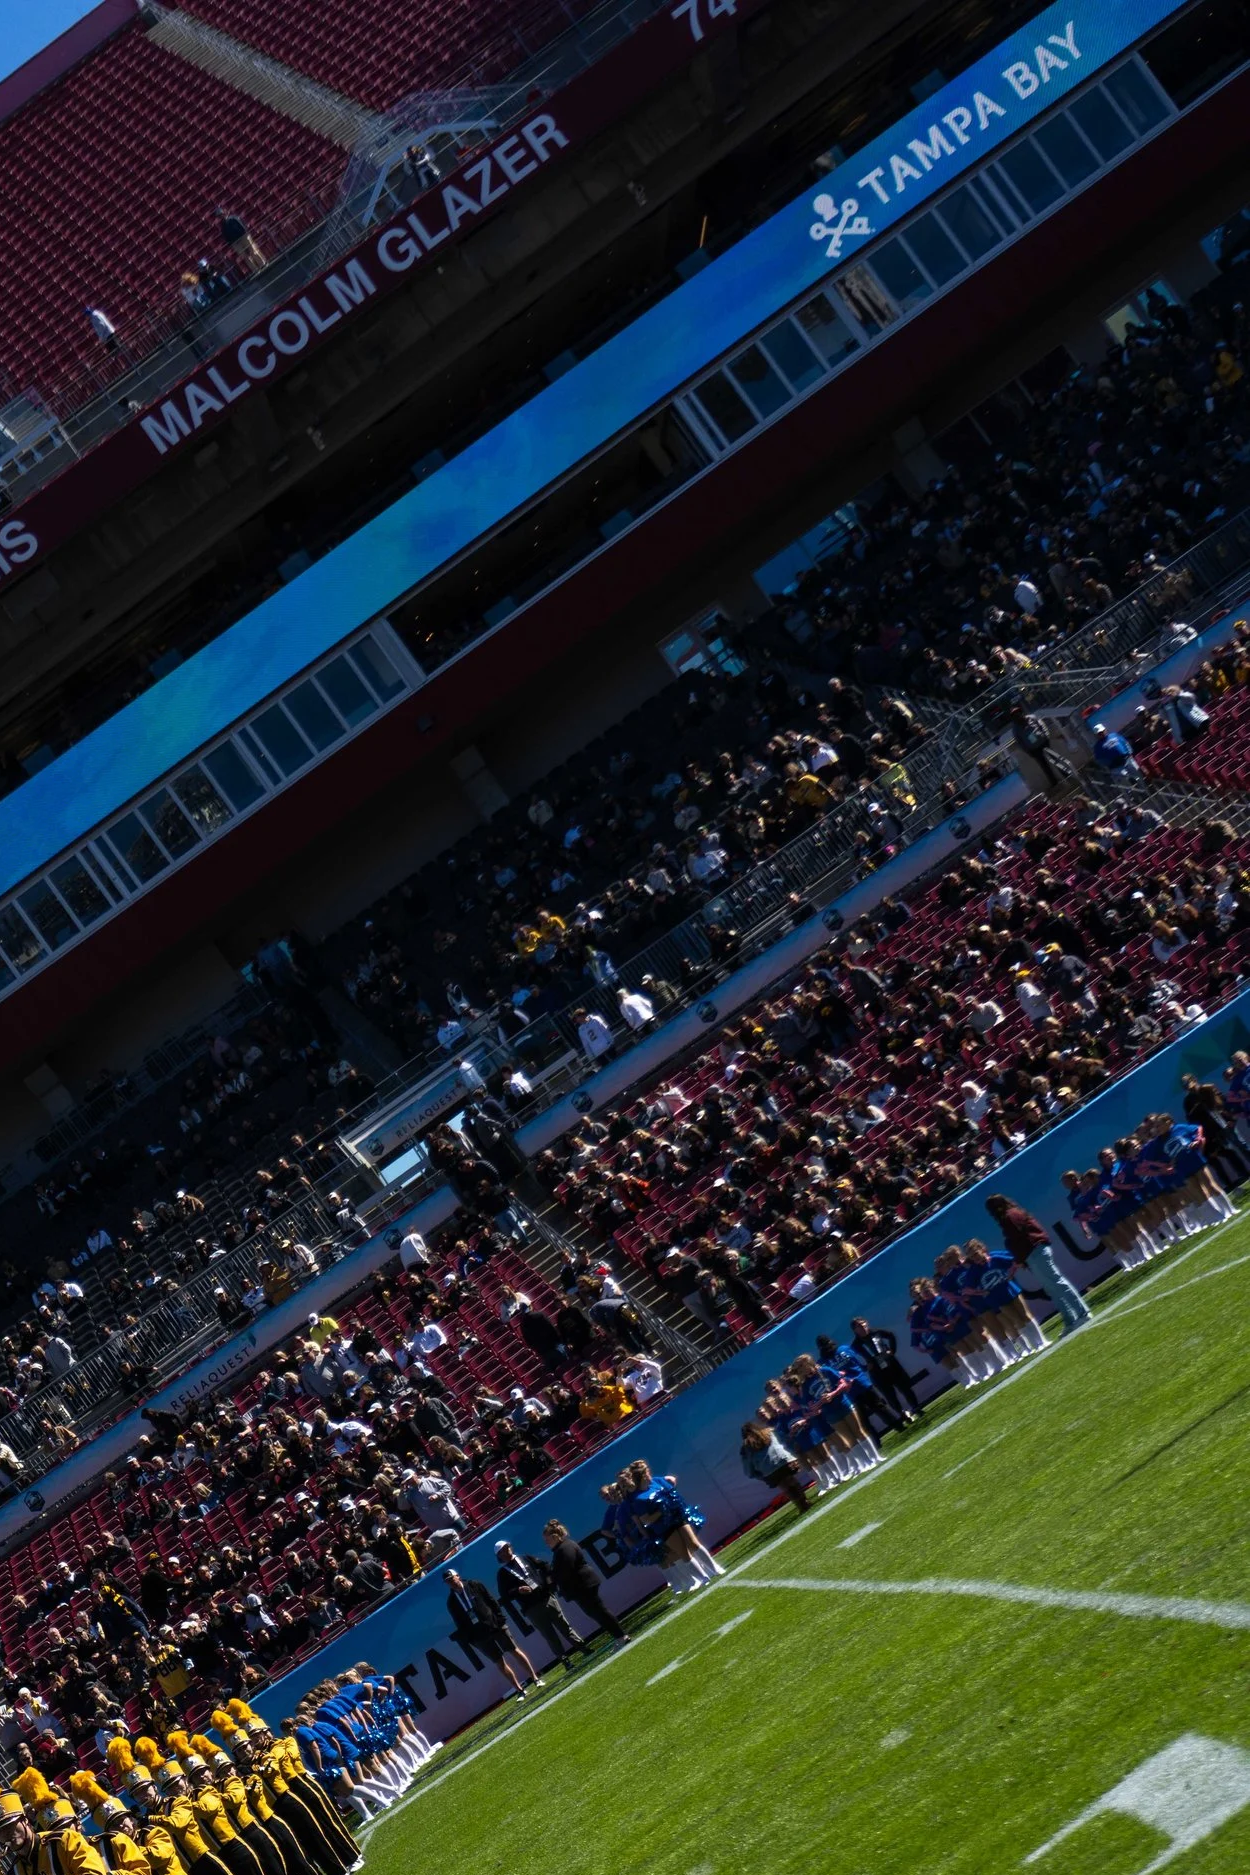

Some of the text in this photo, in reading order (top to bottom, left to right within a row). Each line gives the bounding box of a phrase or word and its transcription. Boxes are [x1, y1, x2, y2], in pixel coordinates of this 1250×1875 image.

[859, 21, 1081, 203] TAMPA BAY
[140, 113, 570, 455] MALCOLM GLAZER
[170, 1346, 250, 1411] RELIAQUEST
